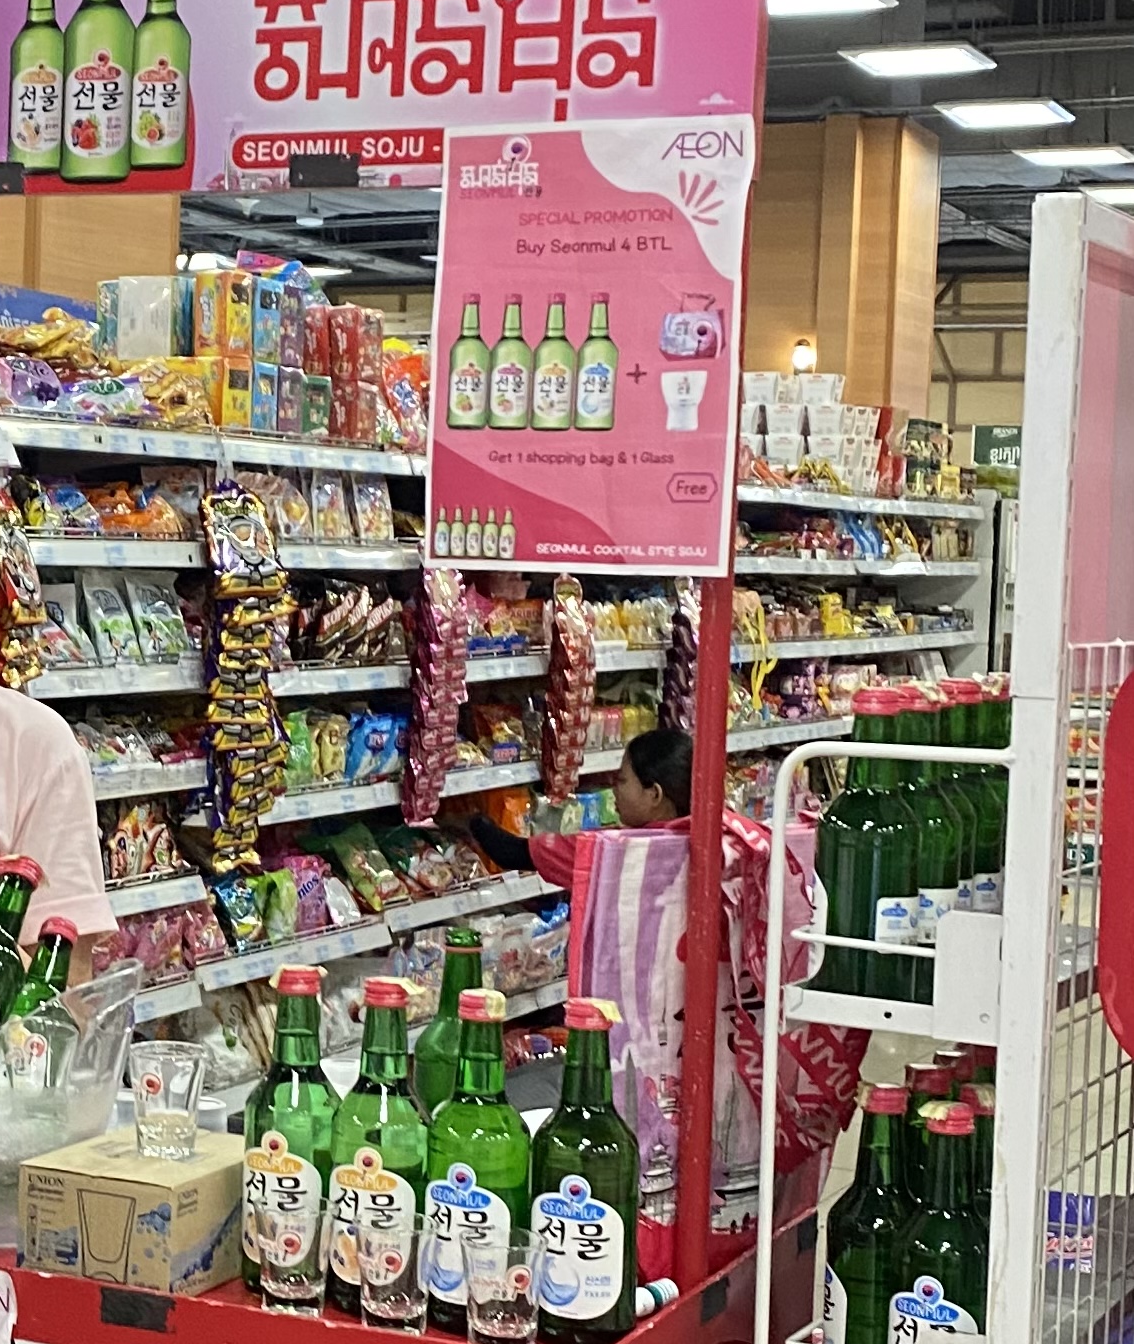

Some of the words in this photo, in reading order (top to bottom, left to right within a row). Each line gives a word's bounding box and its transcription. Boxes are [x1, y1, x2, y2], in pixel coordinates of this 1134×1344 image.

[362, 136, 424, 158] SOJU
[518, 211, 580, 227] SPECIAL
[584, 208, 674, 225] PROMOTION
[516, 239, 546, 256] Buy
[550, 237, 616, 254] Seonmul
[621, 238, 632, 252] 4
[637, 236, 673, 252] BTL
[488, 451, 512, 464] Get
[526, 451, 586, 467] shopping
[589, 452, 614, 467] bag
[617, 451, 628, 464] &
[640, 451, 675, 464] Glass
[676, 479, 708, 495] Free
[28, 1173, 65, 1187] UNION
[897, 1298, 954, 1320] SEONMUL
